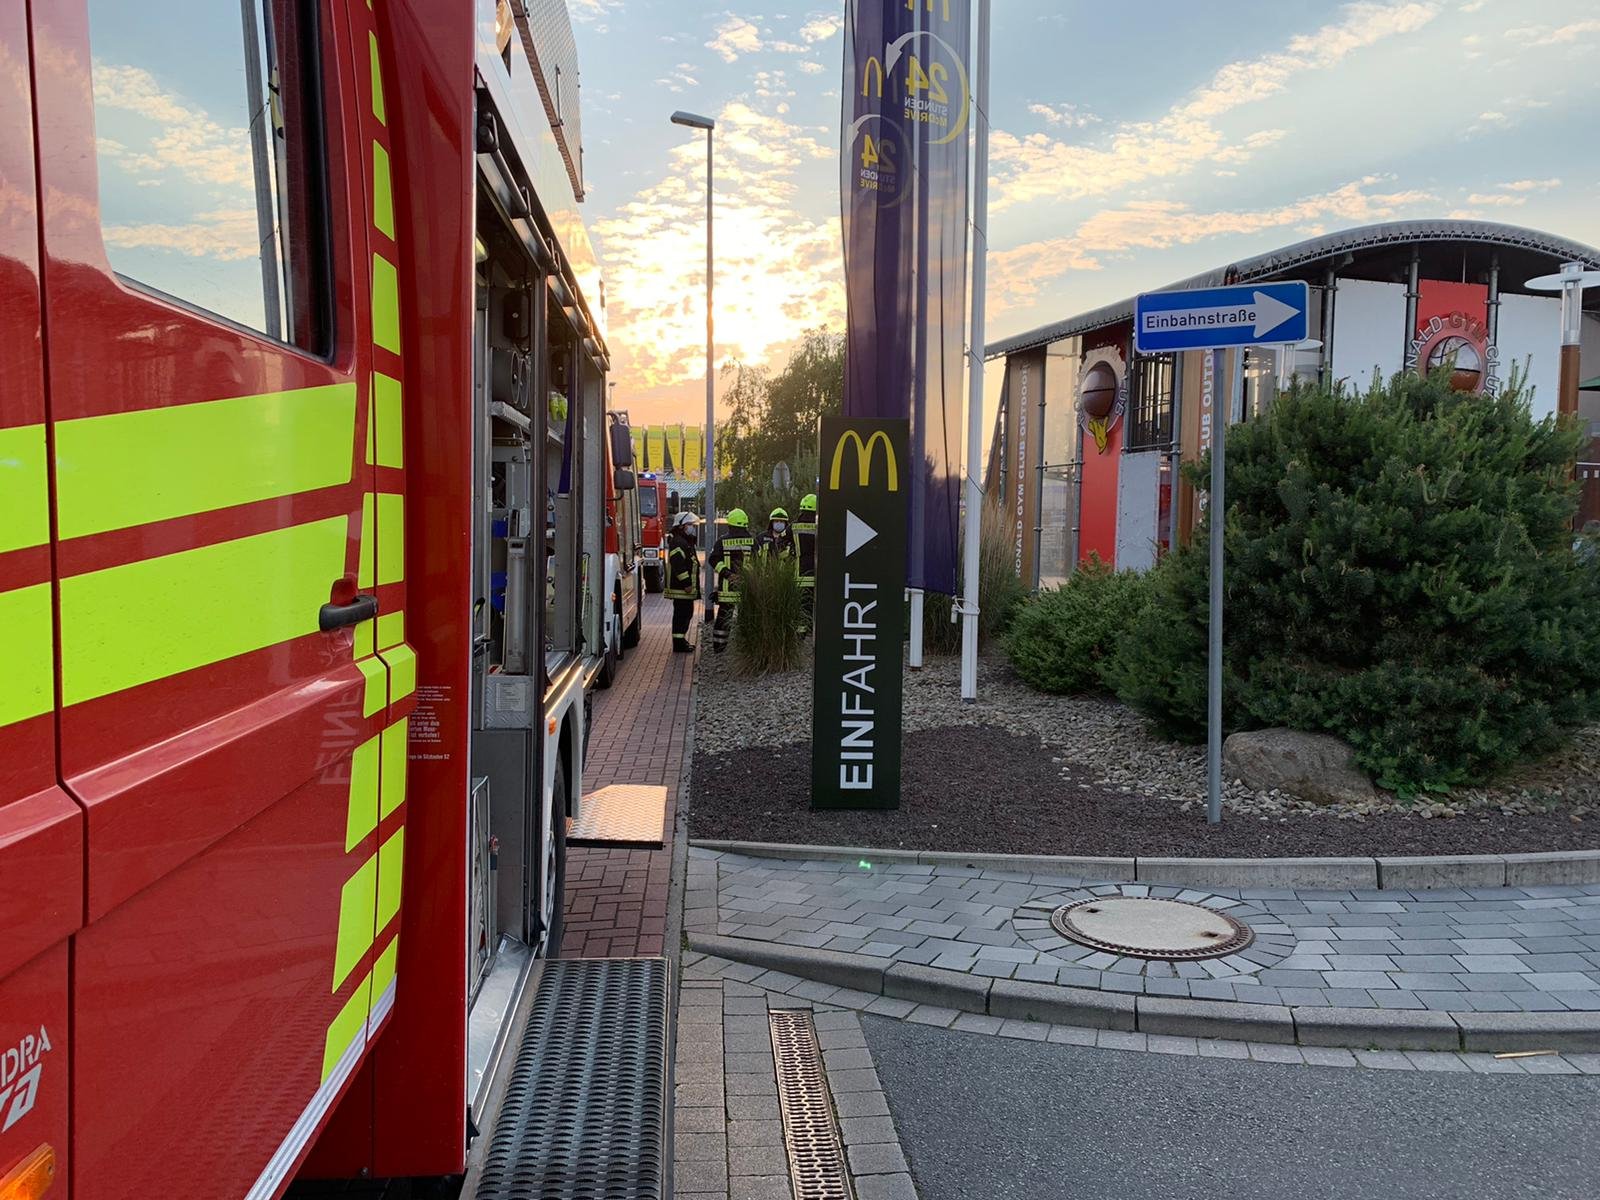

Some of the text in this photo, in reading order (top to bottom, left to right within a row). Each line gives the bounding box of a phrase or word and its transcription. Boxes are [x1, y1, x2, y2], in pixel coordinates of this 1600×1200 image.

[1146, 309, 1257, 329] Einbahnstraße
[1018, 441, 1026, 479] CLUB
[1016, 483, 1025, 516] GYM
[840, 572, 878, 790] EINFAHRT
